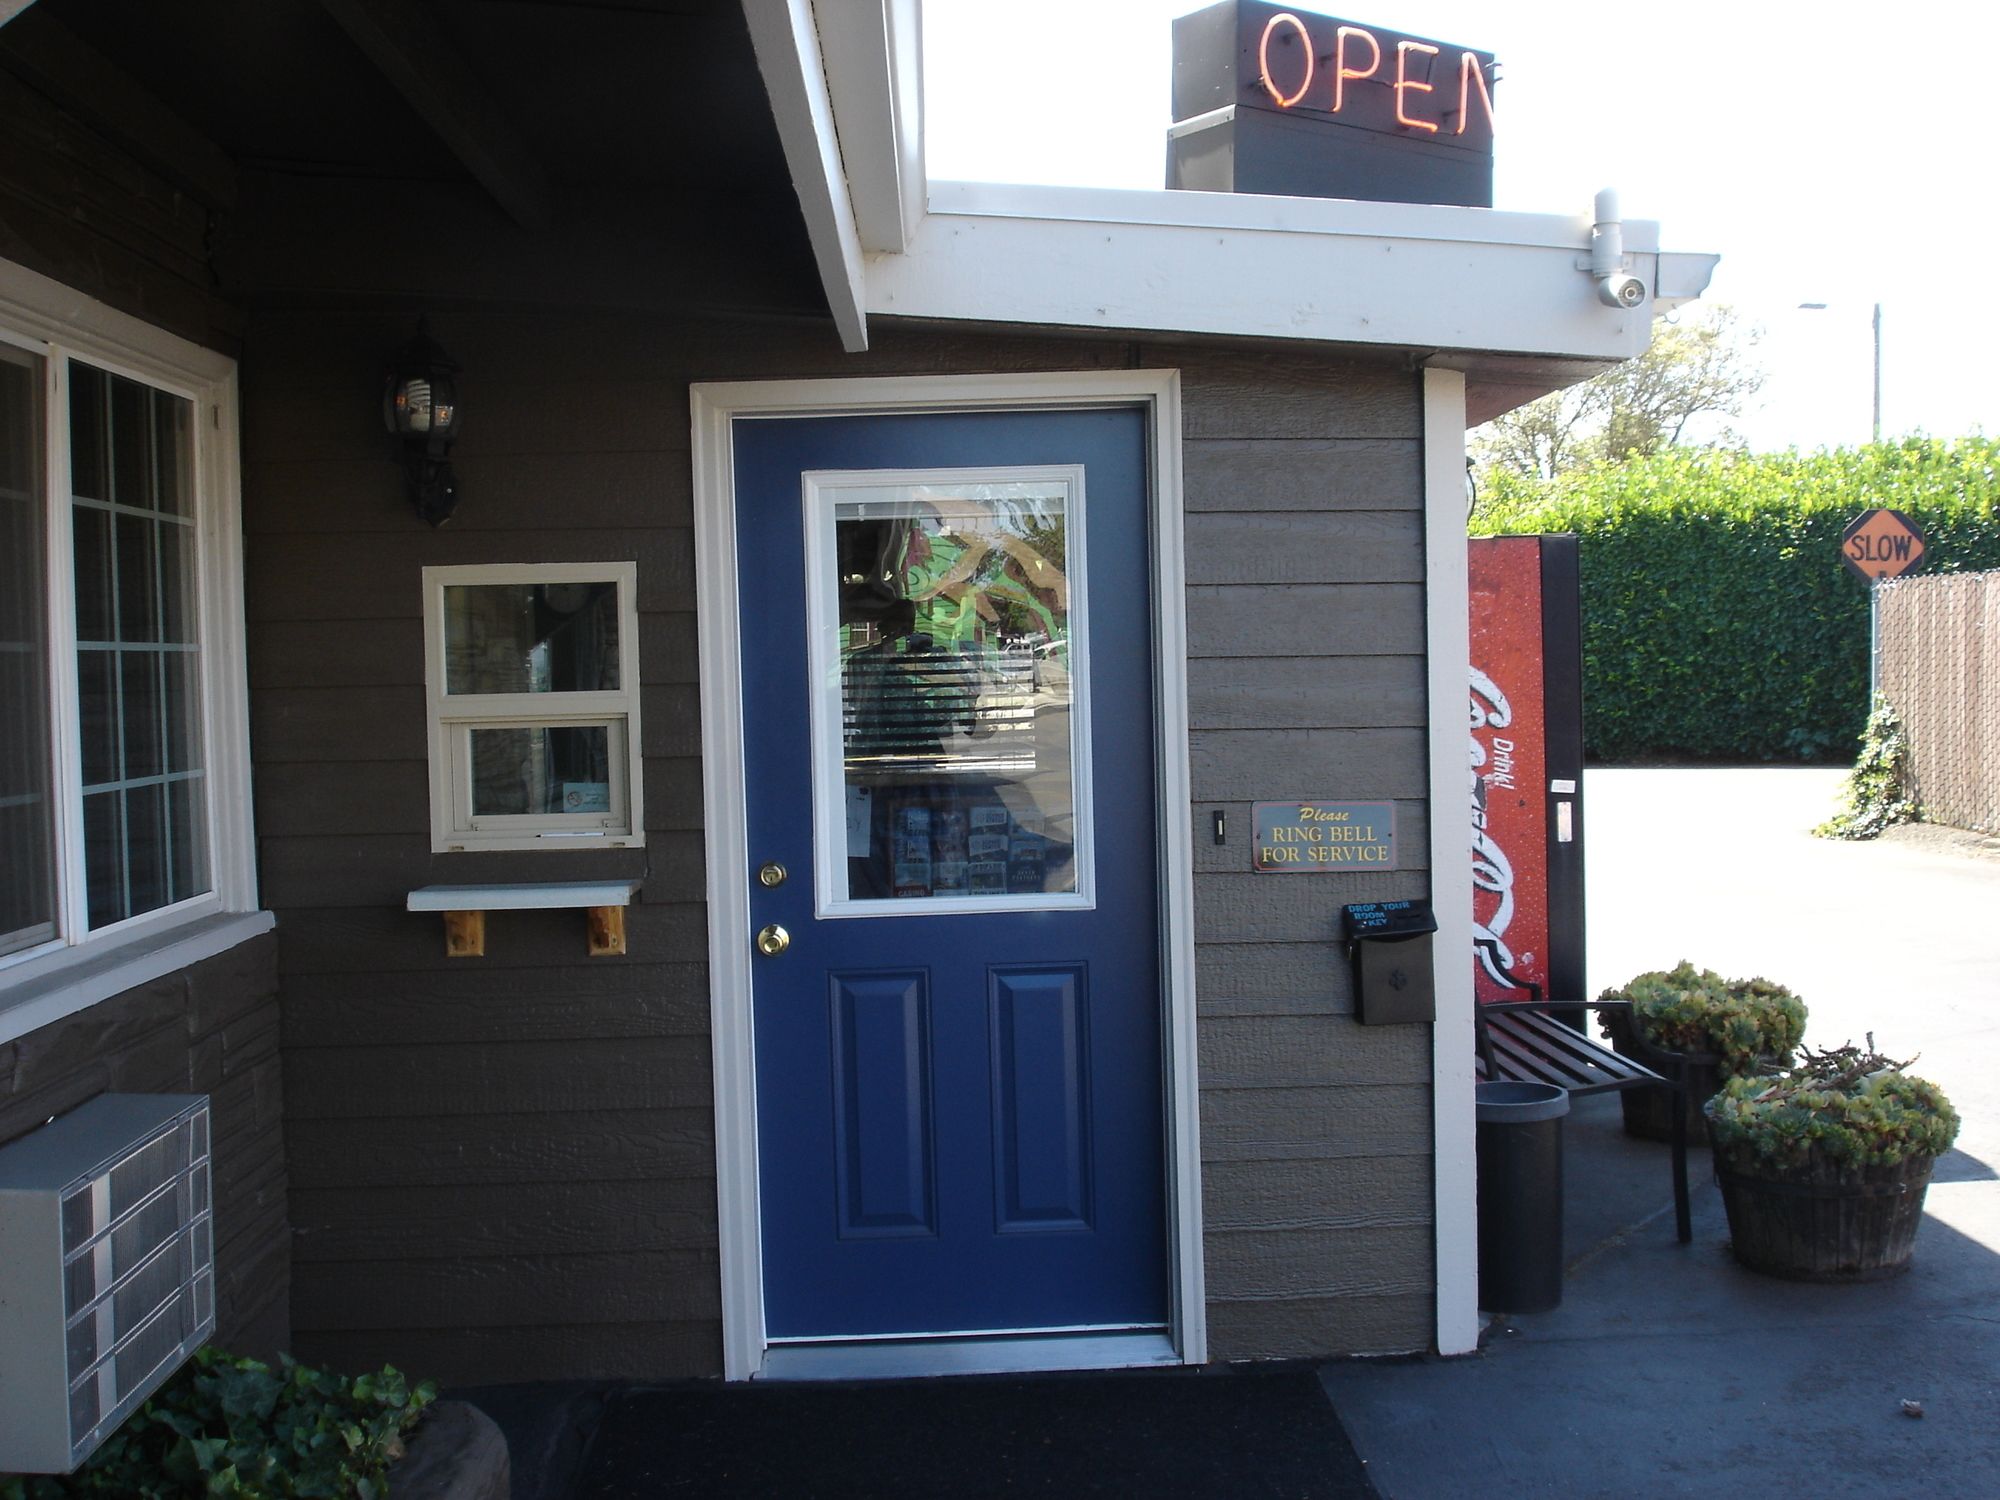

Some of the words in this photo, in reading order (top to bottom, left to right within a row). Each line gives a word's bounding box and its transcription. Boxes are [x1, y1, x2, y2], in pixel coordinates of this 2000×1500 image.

[1260, 13, 1494, 136] OPEN
[1850, 534, 1912, 562] SLOW
[1493, 737, 1515, 790] Drink!
[1299, 807, 1349, 822] Please
[1273, 827, 1322, 843] RING
[1330, 826, 1377, 842] BELL
[1262, 847, 1300, 863] FOR
[1308, 845, 1389, 862] SERVICE
[1348, 904, 1377, 913] DROP
[1381, 901, 1410, 911] YOUR
[1354, 911, 1385, 920] ROOM
[1368, 918, 1388, 927] KEY
